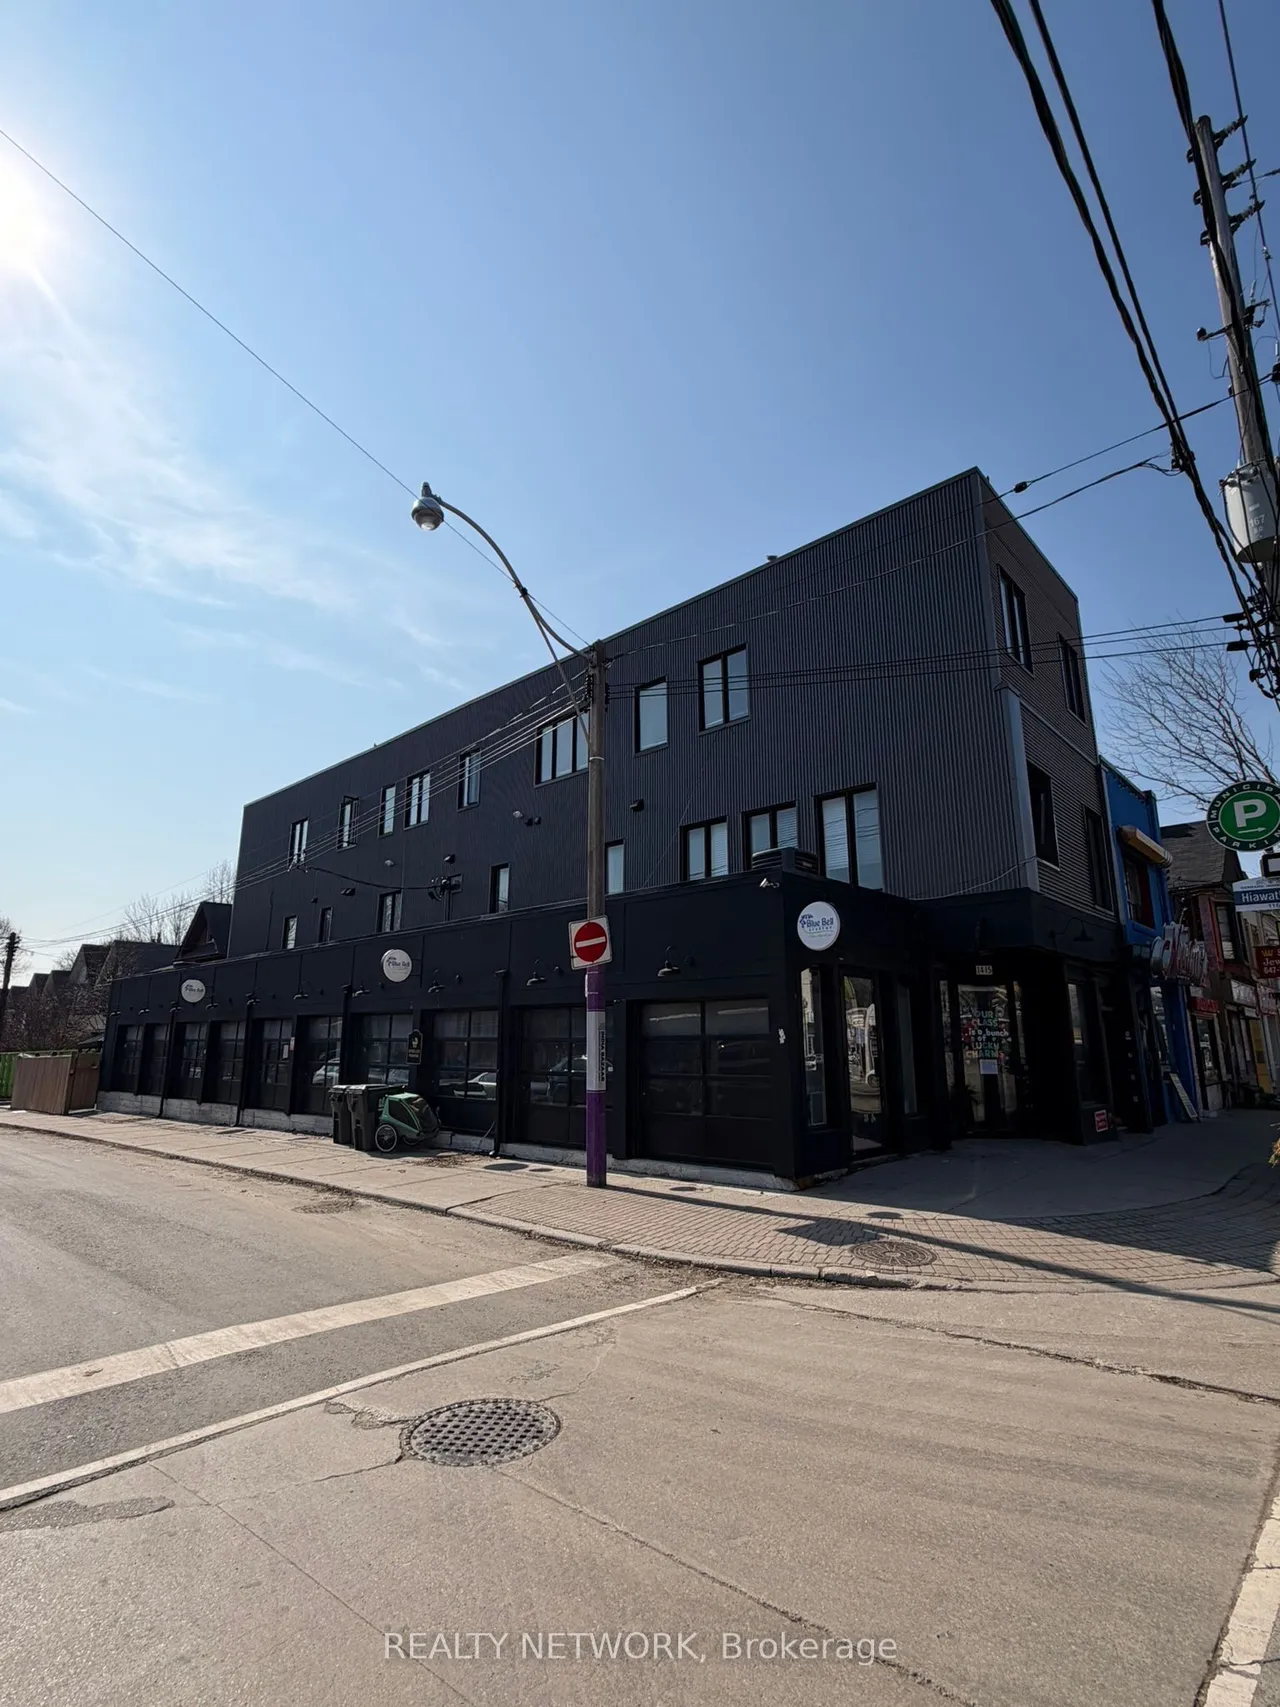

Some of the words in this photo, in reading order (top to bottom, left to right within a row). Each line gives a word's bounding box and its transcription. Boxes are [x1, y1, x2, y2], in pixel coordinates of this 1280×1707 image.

[1233, 799, 1267, 828] P
[1241, 890, 1280, 902] Hiawat
[807, 919, 820, 927] Blue
[821, 917, 834, 926] Bell
[971, 1019, 998, 1027] CLASS
[985, 1028, 1009, 1037] bunch
[972, 1042, 999, 1050] LUCKY
[965, 1050, 1004, 1059] CHARM
